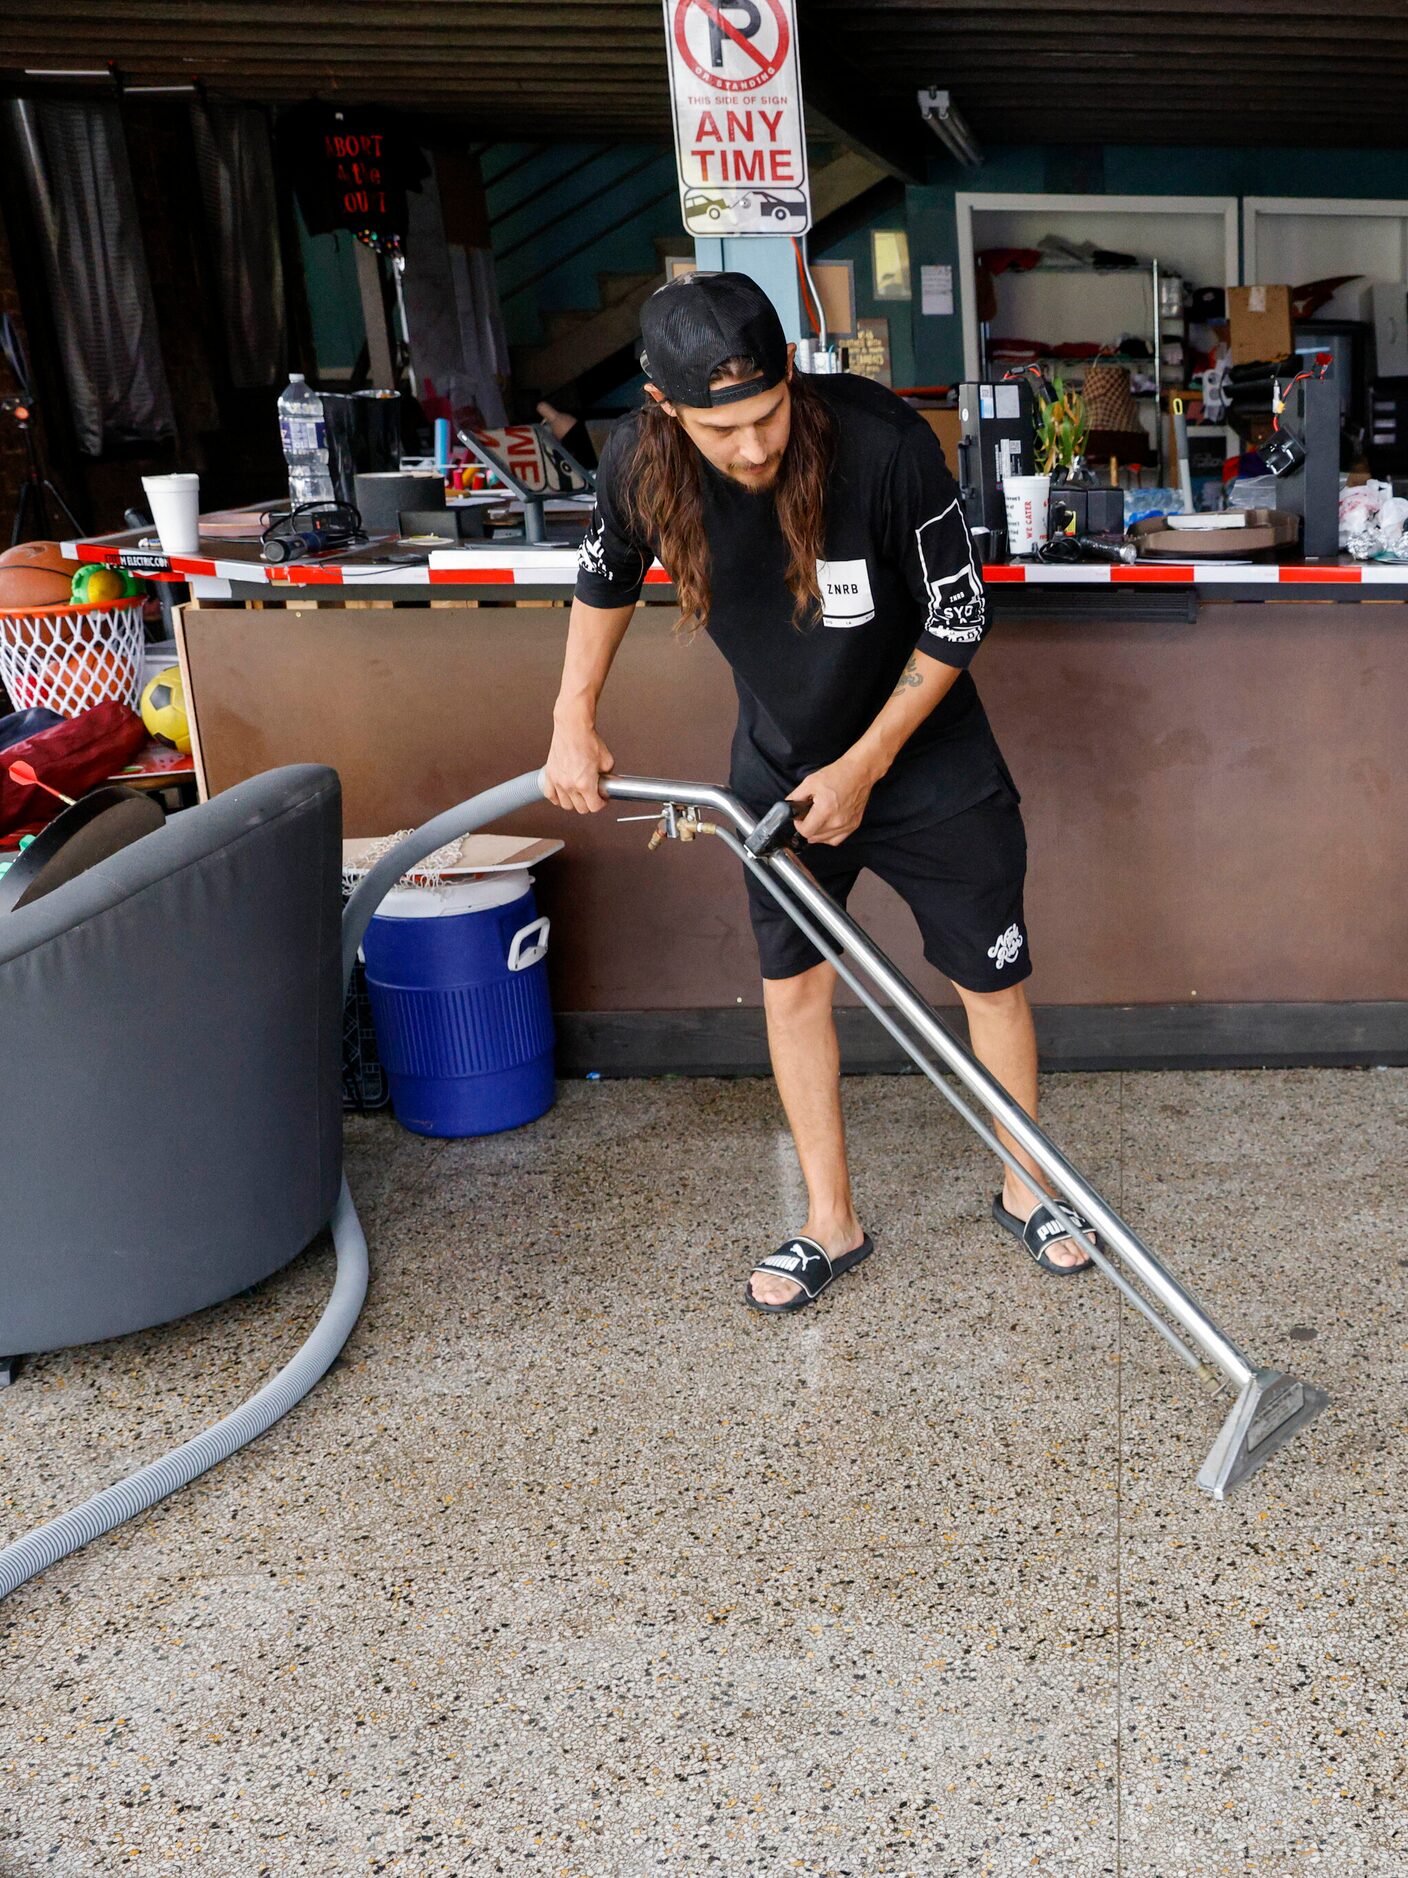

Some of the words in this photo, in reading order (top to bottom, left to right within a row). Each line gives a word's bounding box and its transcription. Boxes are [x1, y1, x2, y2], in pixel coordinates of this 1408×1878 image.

[694, 66, 711, 81] OR
[716, 66, 775, 90] STANDING
[687, 96, 711, 105] THIS
[715, 96, 739, 105] SIDE
[743, 96, 757, 105] OF
[761, 96, 788, 105] SIGN
[695, 110, 784, 142] ANY
[690, 149, 794, 181] TIME
[827, 583, 859, 595] ZNRB
